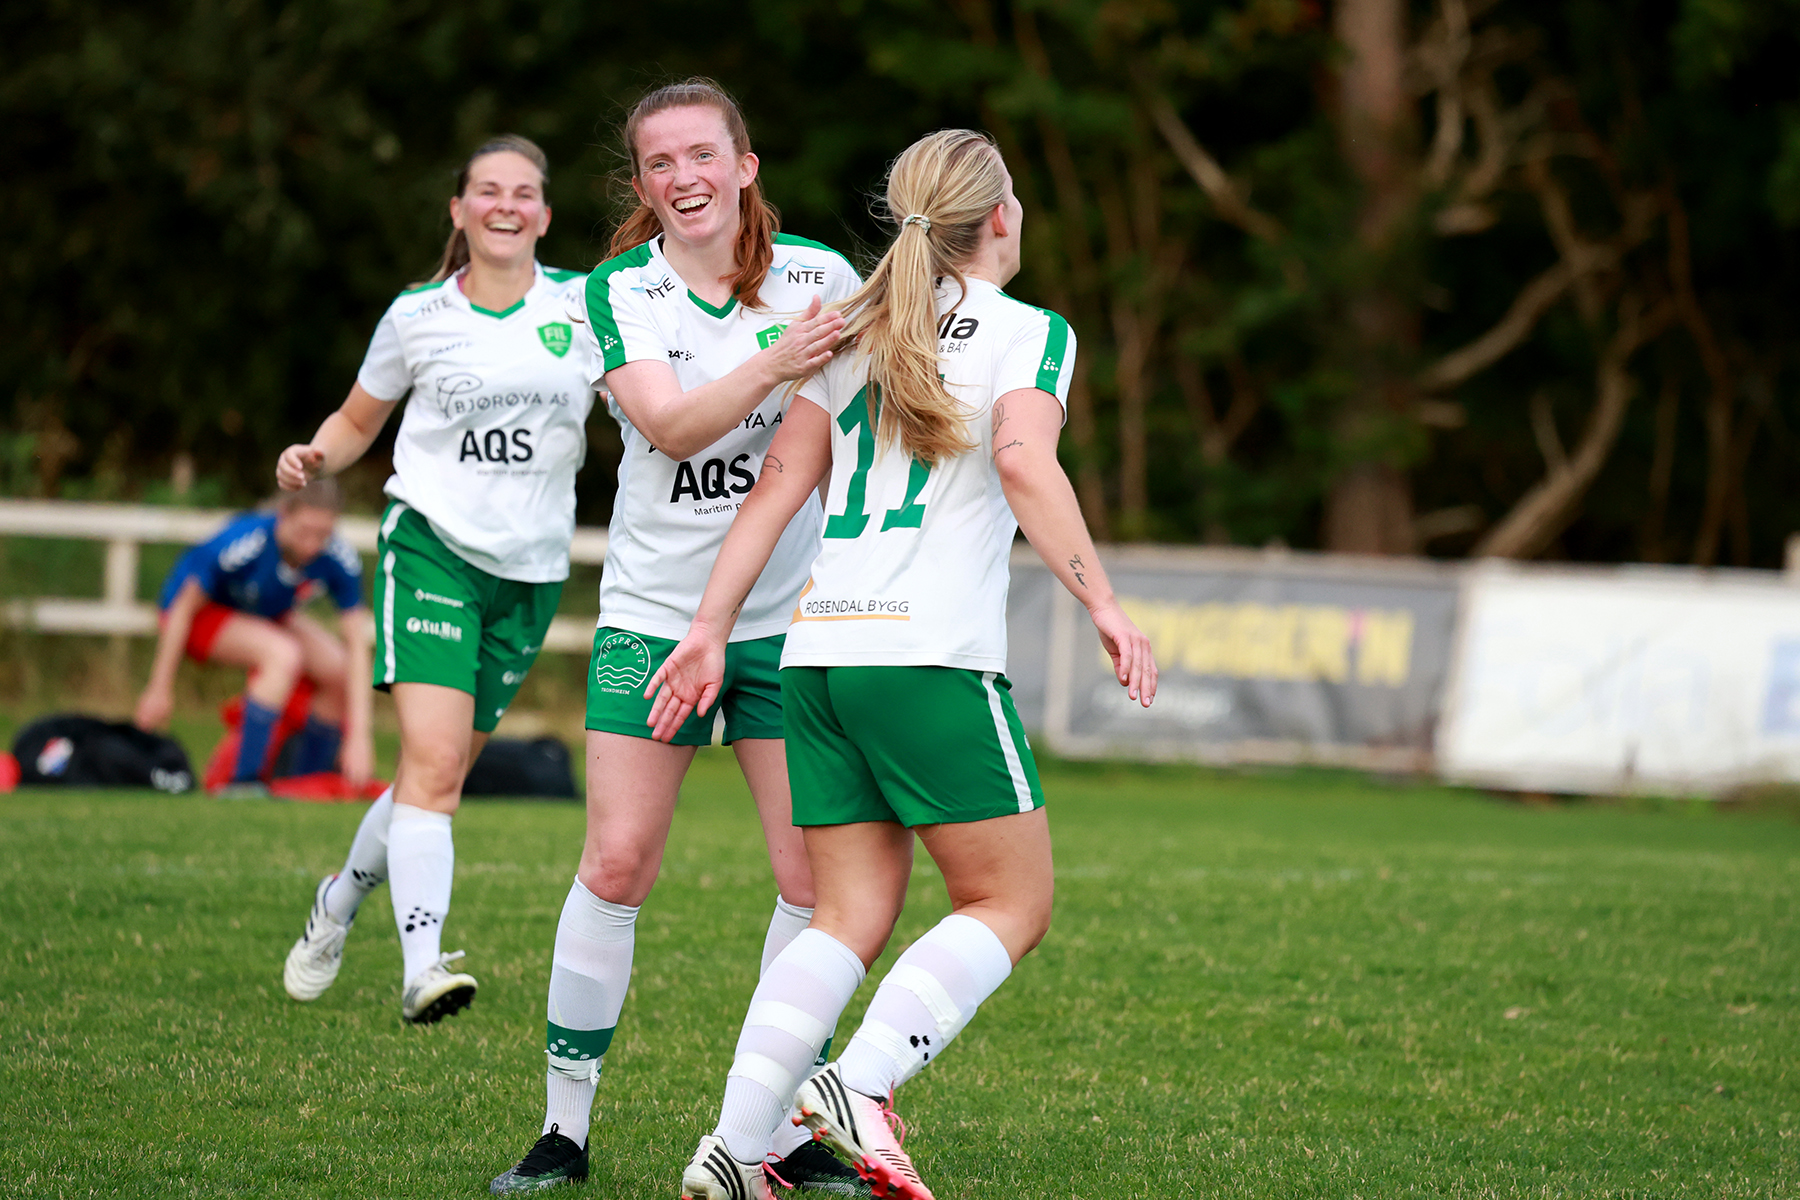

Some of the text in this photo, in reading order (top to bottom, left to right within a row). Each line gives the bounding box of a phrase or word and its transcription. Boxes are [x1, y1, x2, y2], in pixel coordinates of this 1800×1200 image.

[646, 277, 676, 300] NTE
[788, 270, 825, 285] NTE
[421, 295, 453, 317] NTE
[455, 391, 569, 414] BJØRØYA AS
[459, 428, 533, 465] AQS
[669, 452, 756, 504] AQS
[694, 503, 733, 517] Maritim
[804, 599, 910, 614] ROSENDAL BYGG
[601, 636, 646, 665] SJØSPRØYT
[600, 686, 631, 696] TRONDHEIM
